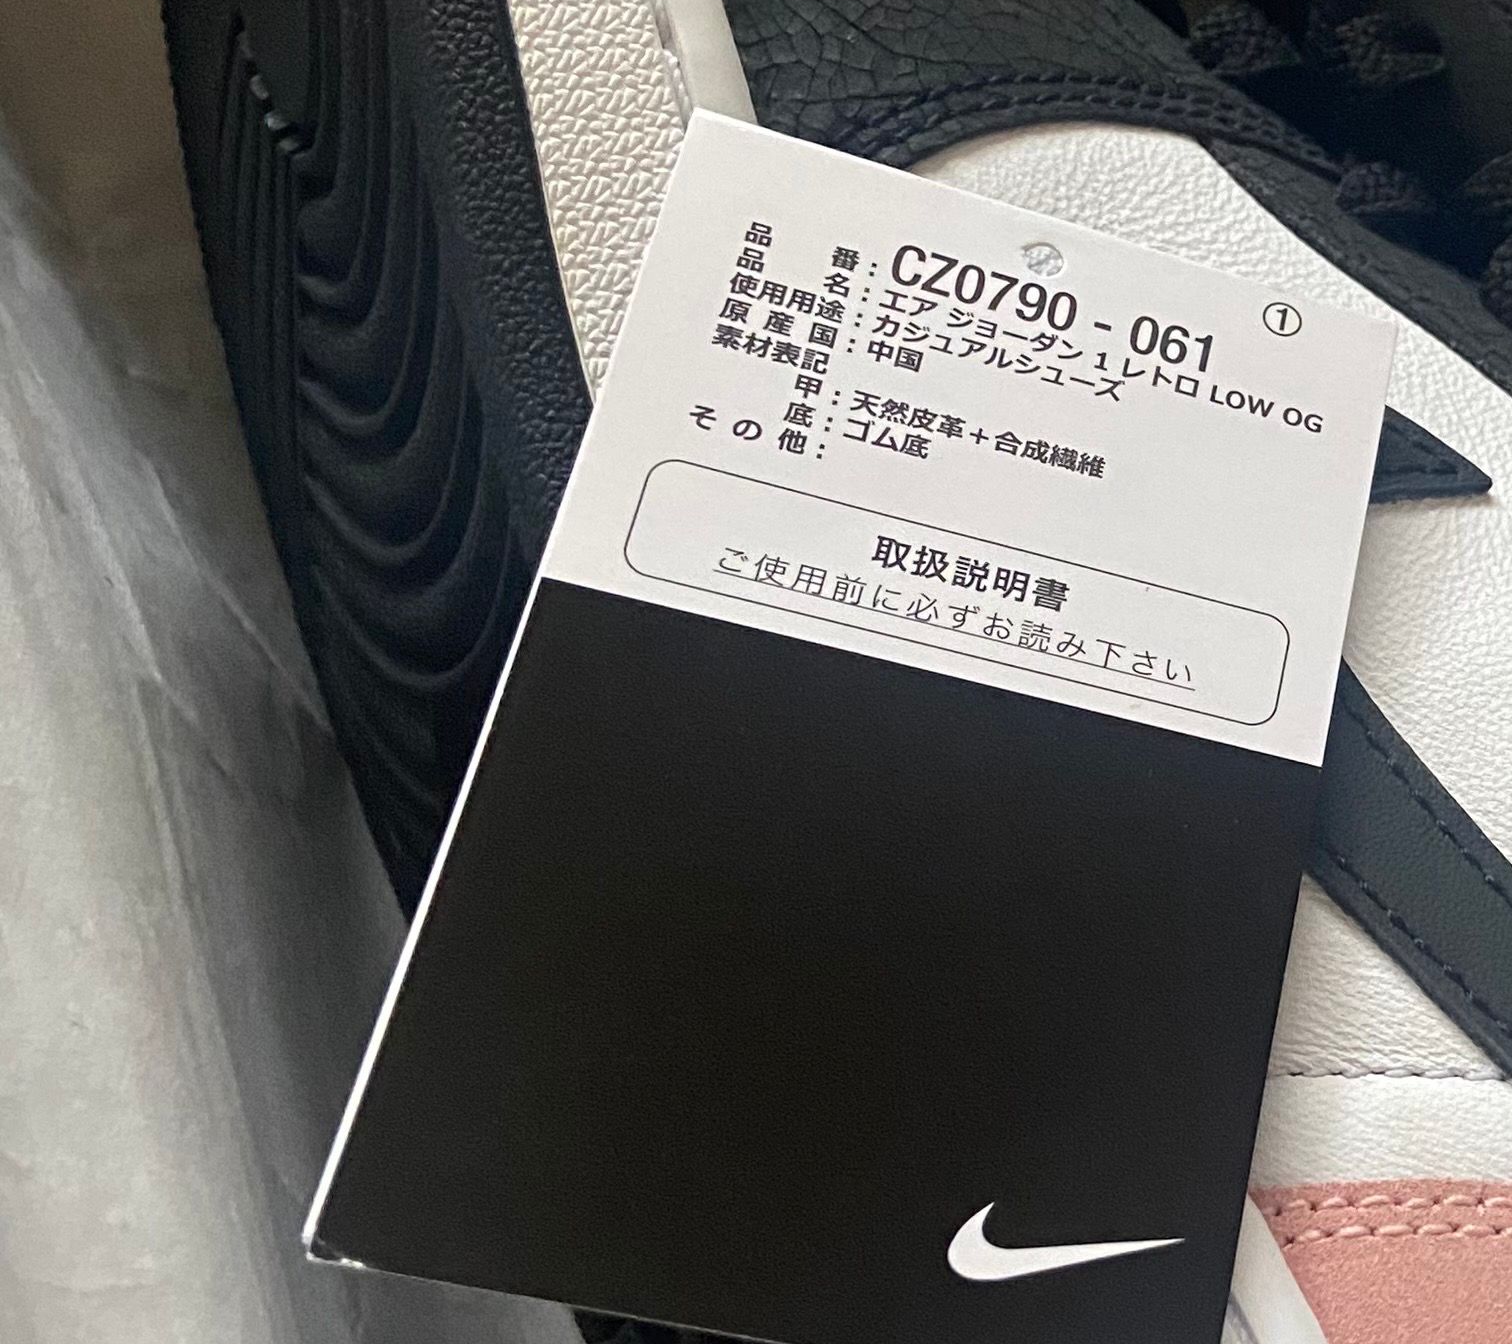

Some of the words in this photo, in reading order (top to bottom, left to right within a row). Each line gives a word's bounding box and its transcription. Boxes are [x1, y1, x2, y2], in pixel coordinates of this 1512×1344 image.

[891, 244, 1077, 331] CZ0790
[1129, 315, 1214, 373] 061
[711, 323, 830, 374] 素材表記
[867, 340, 924, 373] 中国
[872, 314, 1126, 402] カジュアルシューズ
[1094, 351, 1108, 371] 1
[1122, 357, 1200, 398] レトロ
[1209, 384, 1275, 418] LOW
[1282, 406, 1324, 433] OG
[843, 417, 932, 460] ゴム底
[871, 535, 1070, 612] 取扱説明書
[717, 547, 1192, 683] ご使用前に必ずお読み下さい
